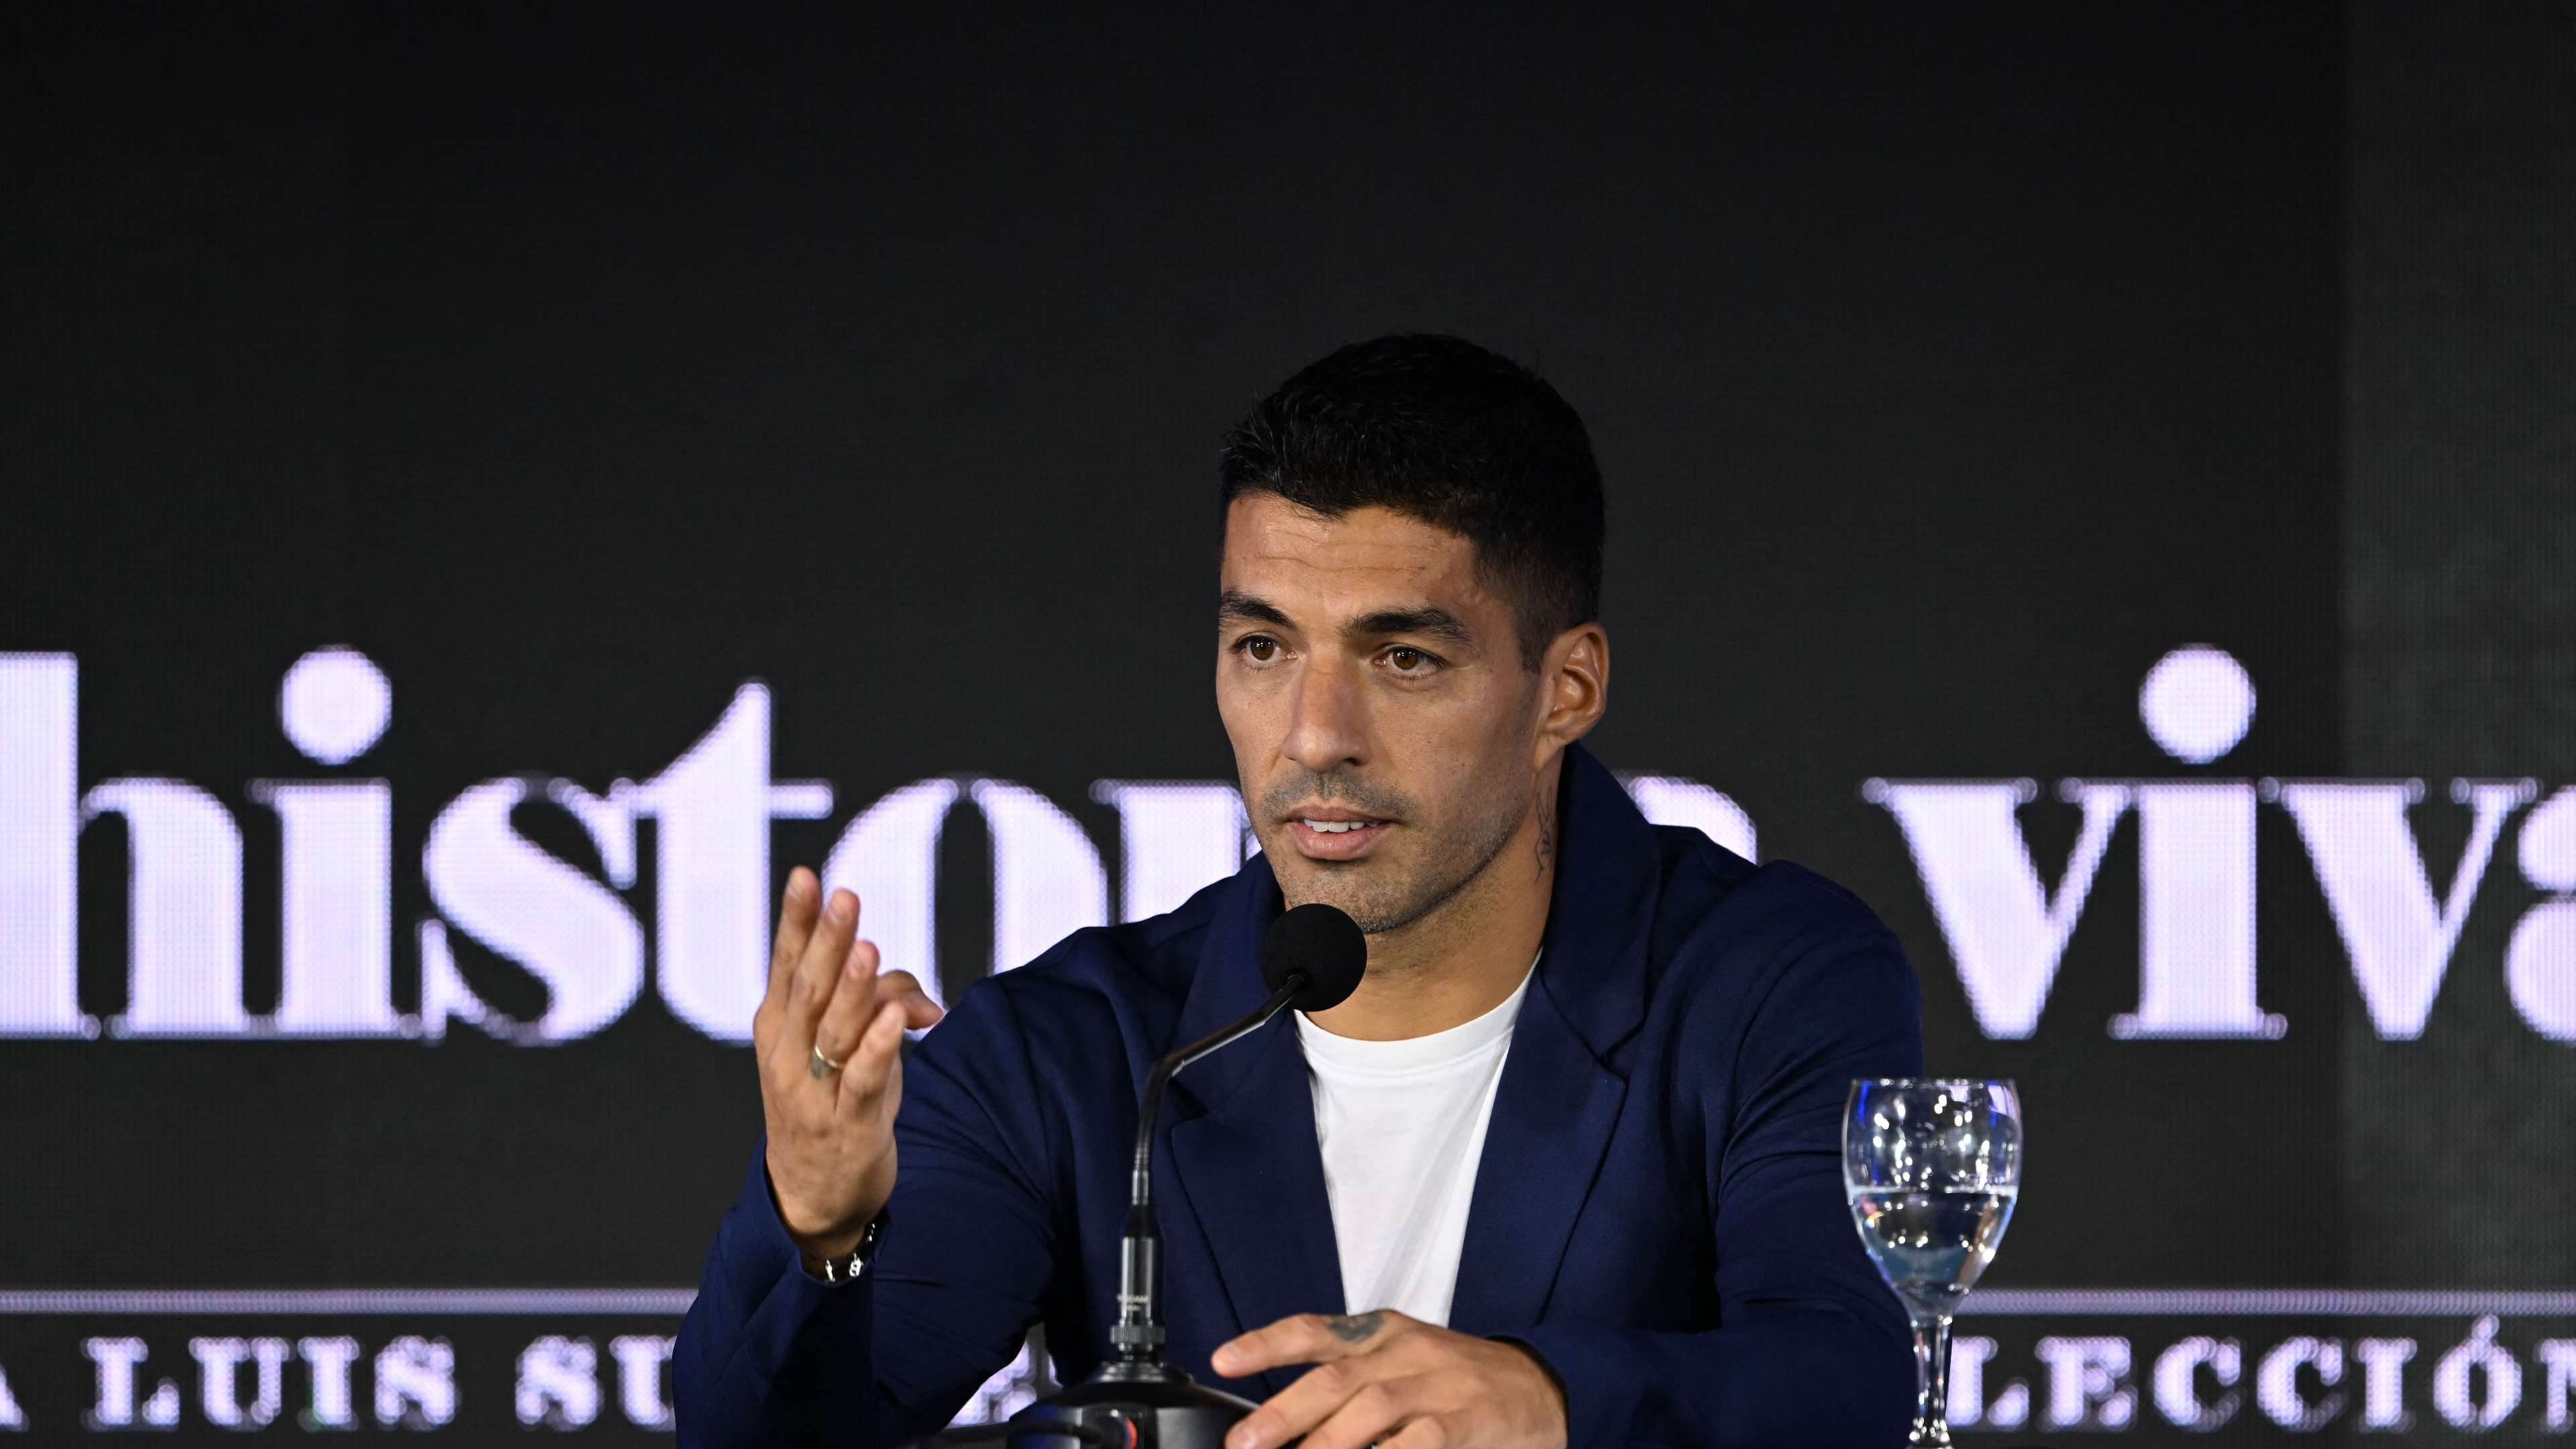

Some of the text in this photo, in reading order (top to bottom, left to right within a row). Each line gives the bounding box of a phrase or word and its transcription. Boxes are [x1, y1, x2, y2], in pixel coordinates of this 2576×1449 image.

[1862, 643, 2576, 1047] viv
[84, 1335, 460, 1432] LUIS
[1945, 1313, 2576, 1433] LECCIÓ
